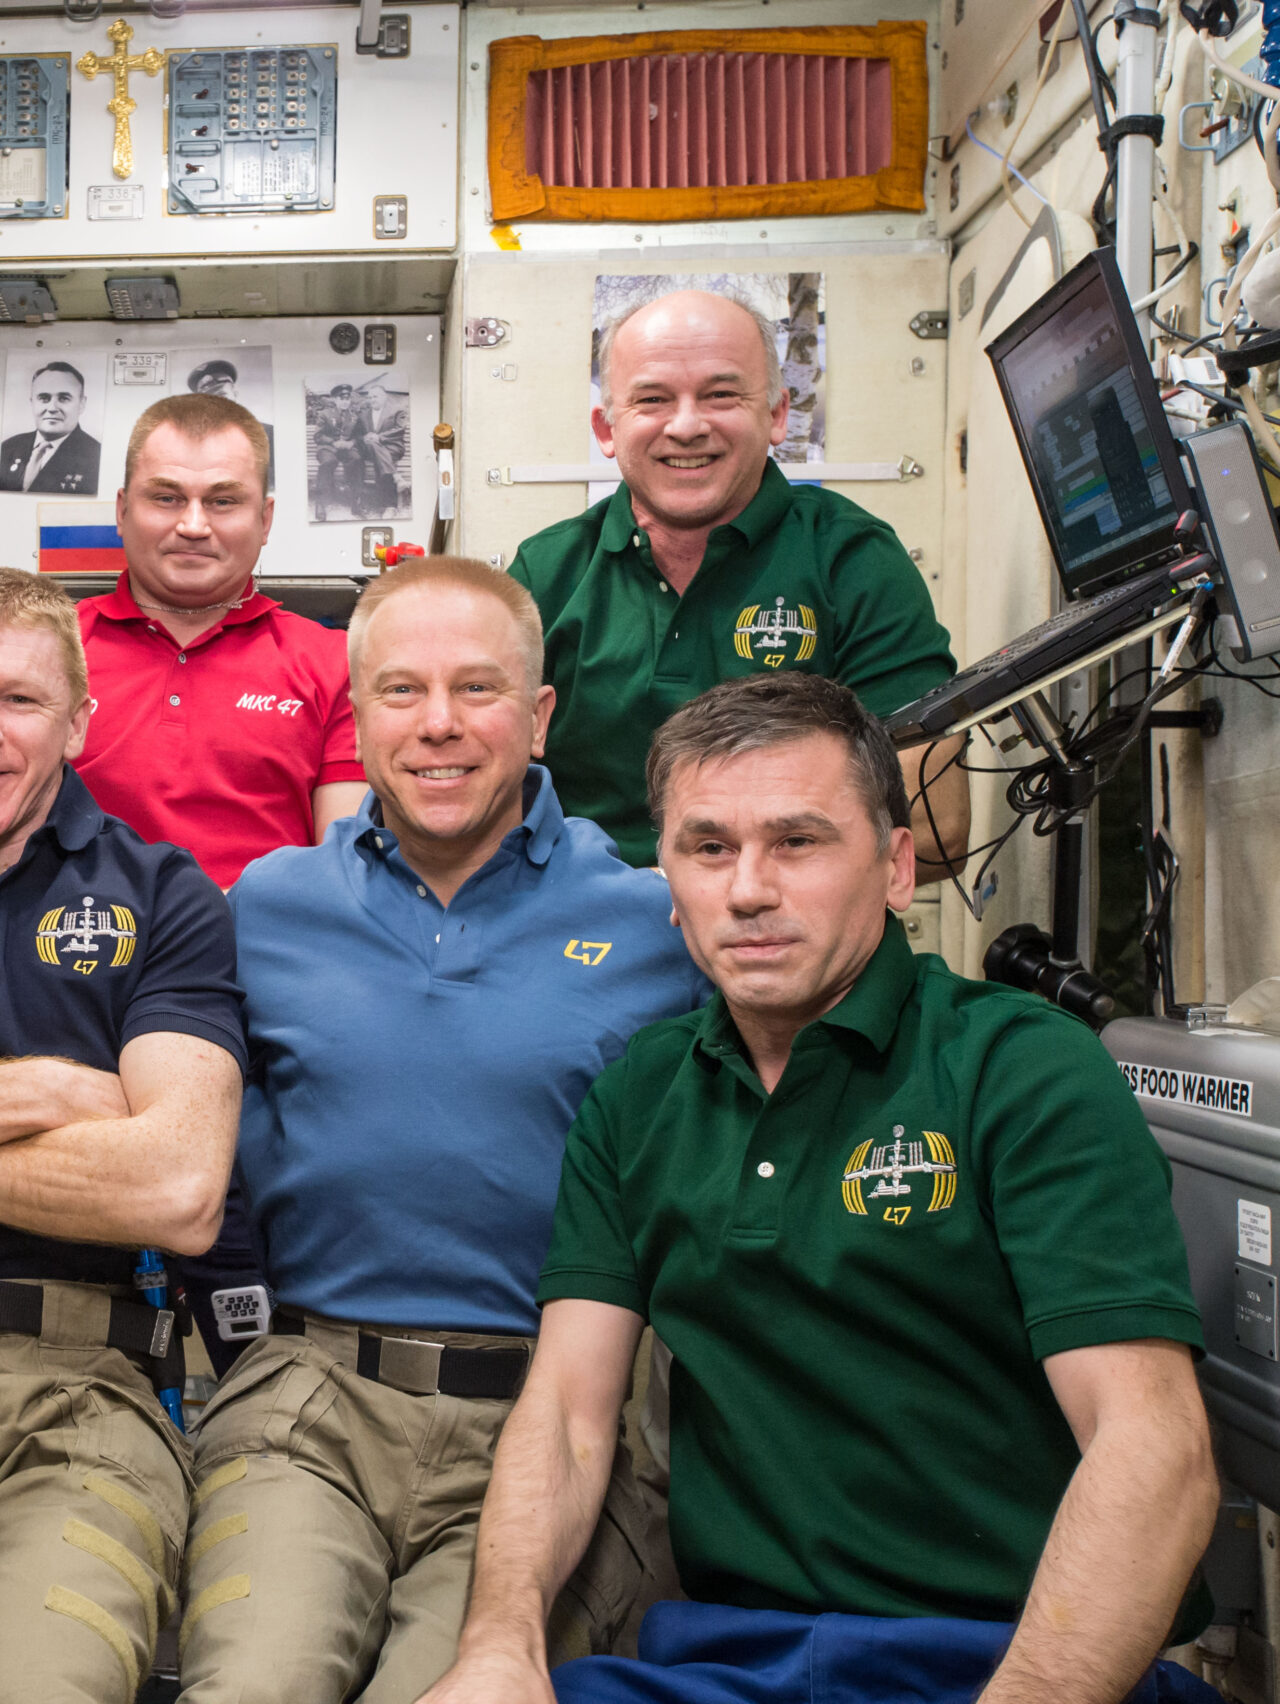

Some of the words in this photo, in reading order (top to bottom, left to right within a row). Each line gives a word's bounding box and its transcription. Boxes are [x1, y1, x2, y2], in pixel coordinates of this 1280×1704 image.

[107, 188, 129, 199] 338
[132, 355, 152, 366] 339
[764, 653, 786, 668] 47
[277, 699, 304, 717] 47
[563, 939, 613, 966] 47
[72, 959, 99, 976] 47
[1140, 1067, 1179, 1099] FOOD
[1182, 1073, 1250, 1114] WARMER
[883, 1205, 912, 1226] 47
